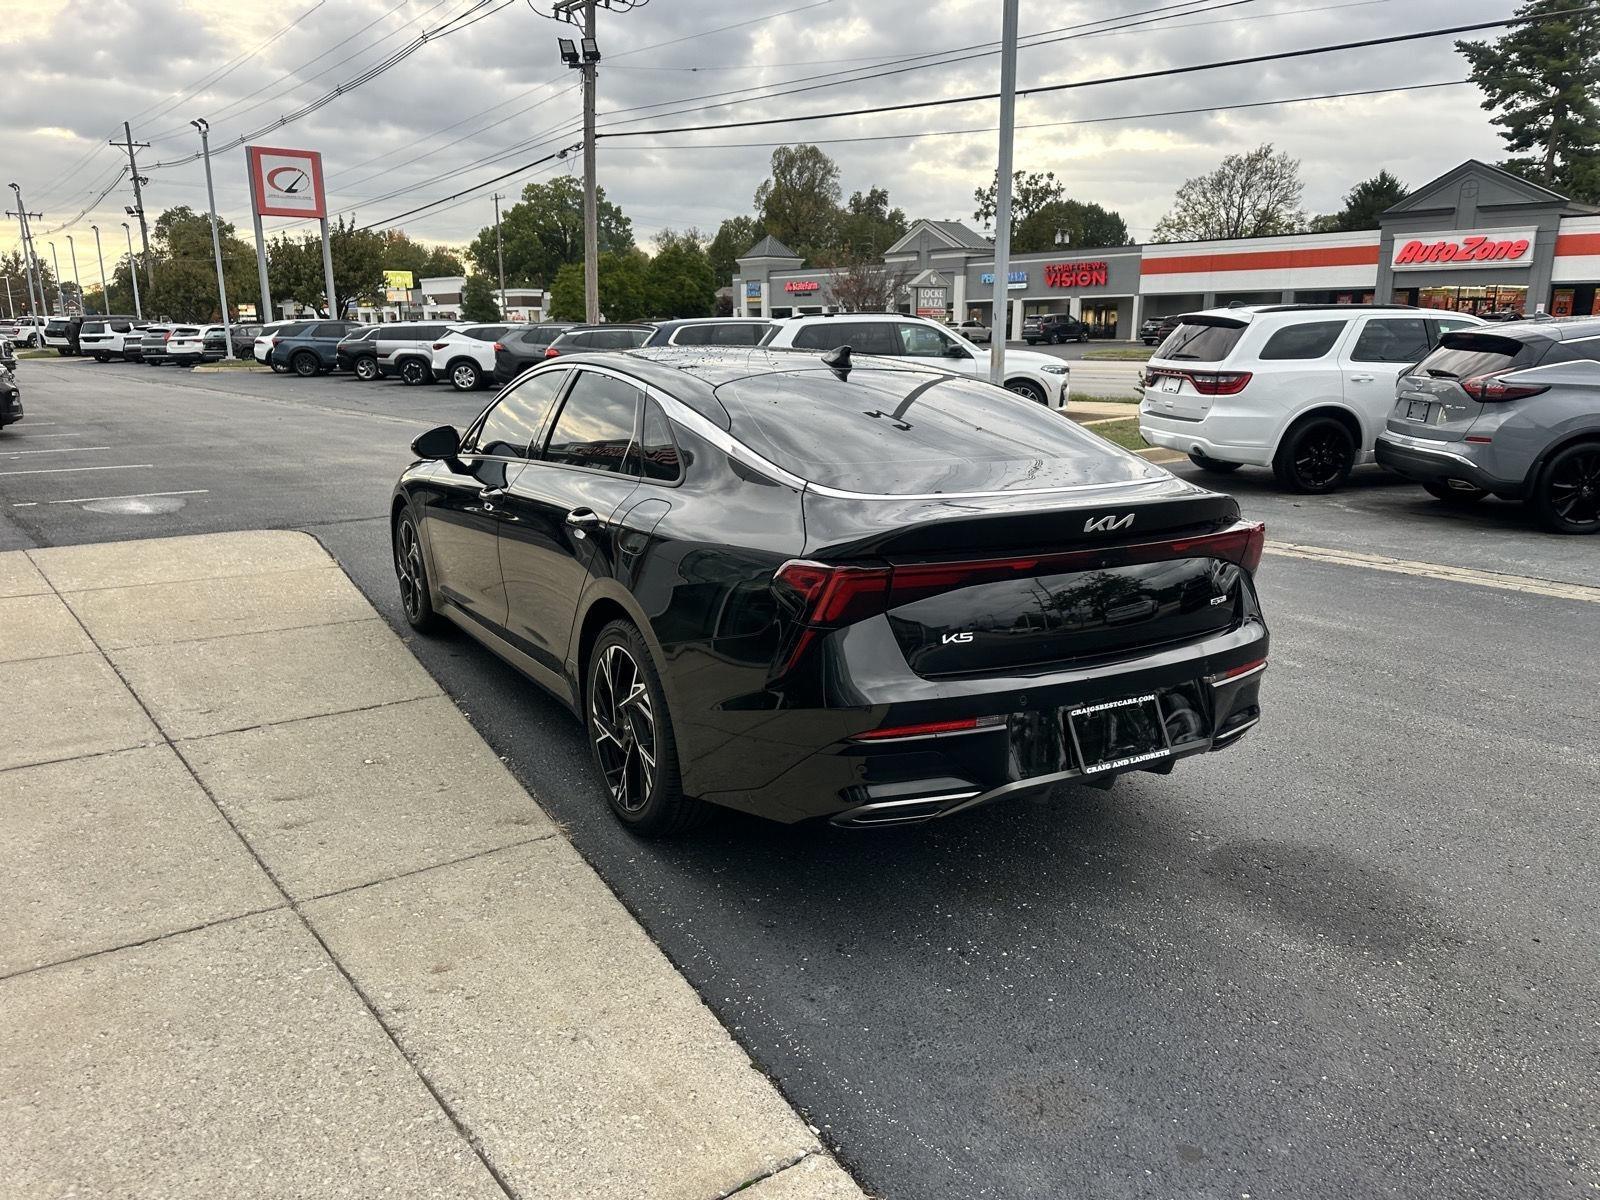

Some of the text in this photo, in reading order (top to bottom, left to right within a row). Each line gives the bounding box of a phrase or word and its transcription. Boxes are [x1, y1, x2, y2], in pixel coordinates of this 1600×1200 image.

[1395, 236, 1530, 265] AutoZone
[1045, 270, 1108, 288] VISION
[920, 289, 944, 298] LOCKE
[920, 299, 943, 307] PLAZA
[942, 631, 974, 644] K5
[1071, 694, 1155, 716] CRAIGSBESTCARS.COM
[1086, 749, 1170, 774] CRAIG AND LANDRETH
